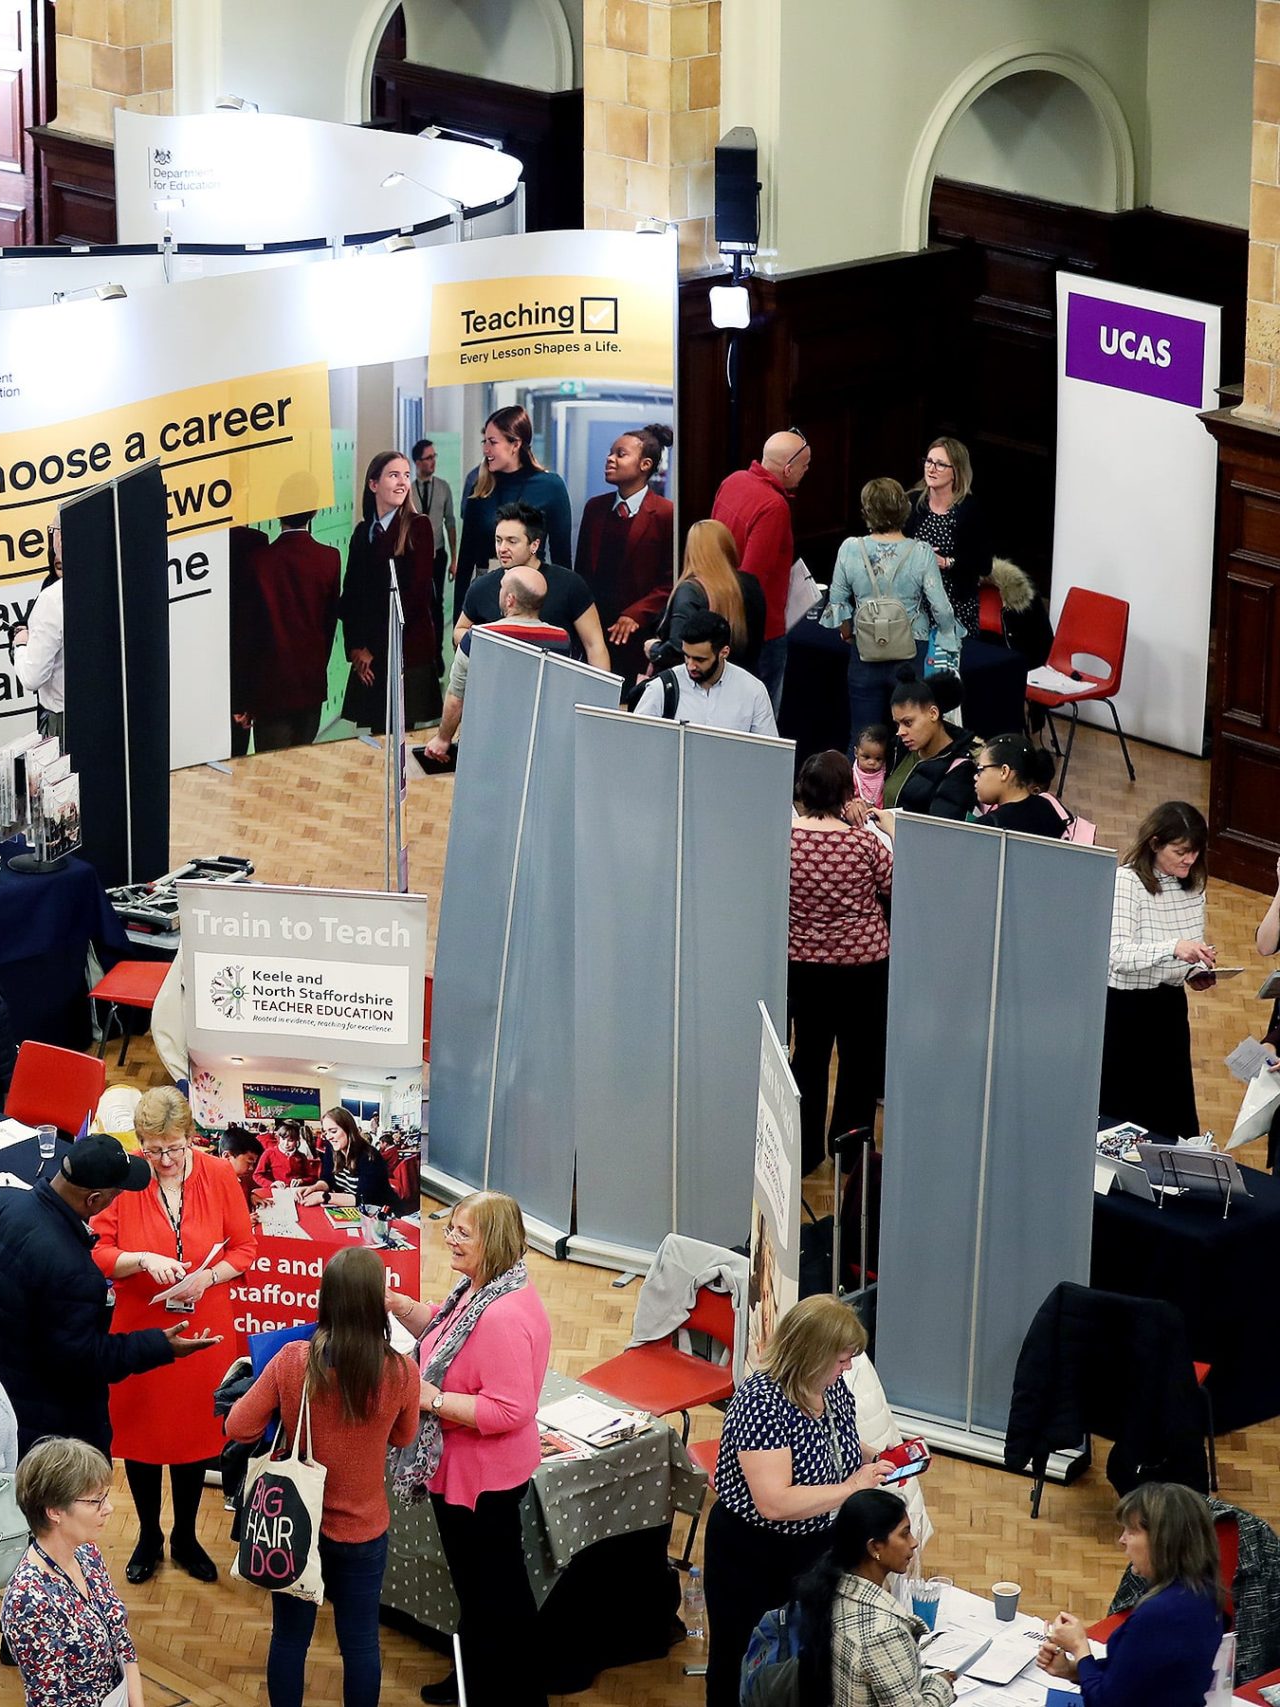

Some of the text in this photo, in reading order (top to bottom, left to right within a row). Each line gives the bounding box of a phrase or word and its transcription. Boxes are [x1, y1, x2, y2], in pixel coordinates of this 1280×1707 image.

[153, 180, 167, 190] for
[461, 301, 574, 334] Teaching
[460, 341, 622, 364] Every Lesson Shapes a Life.
[1099, 325, 1172, 368] UCAS
[124, 431, 146, 463] a
[159, 396, 293, 453] career
[192, 908, 410, 948] Train to Teach
[252, 970, 323, 985] Keele and
[252, 985, 393, 1007] North Staffordshire
[252, 999, 393, 1022] TEACHER EDUCATION
[277, 1257, 323, 1278] and
[233, 1312, 286, 1333] cher
[251, 1476, 285, 1518] BIG
[245, 1509, 294, 1550] HAIR
[250, 1544, 296, 1580] DO!
